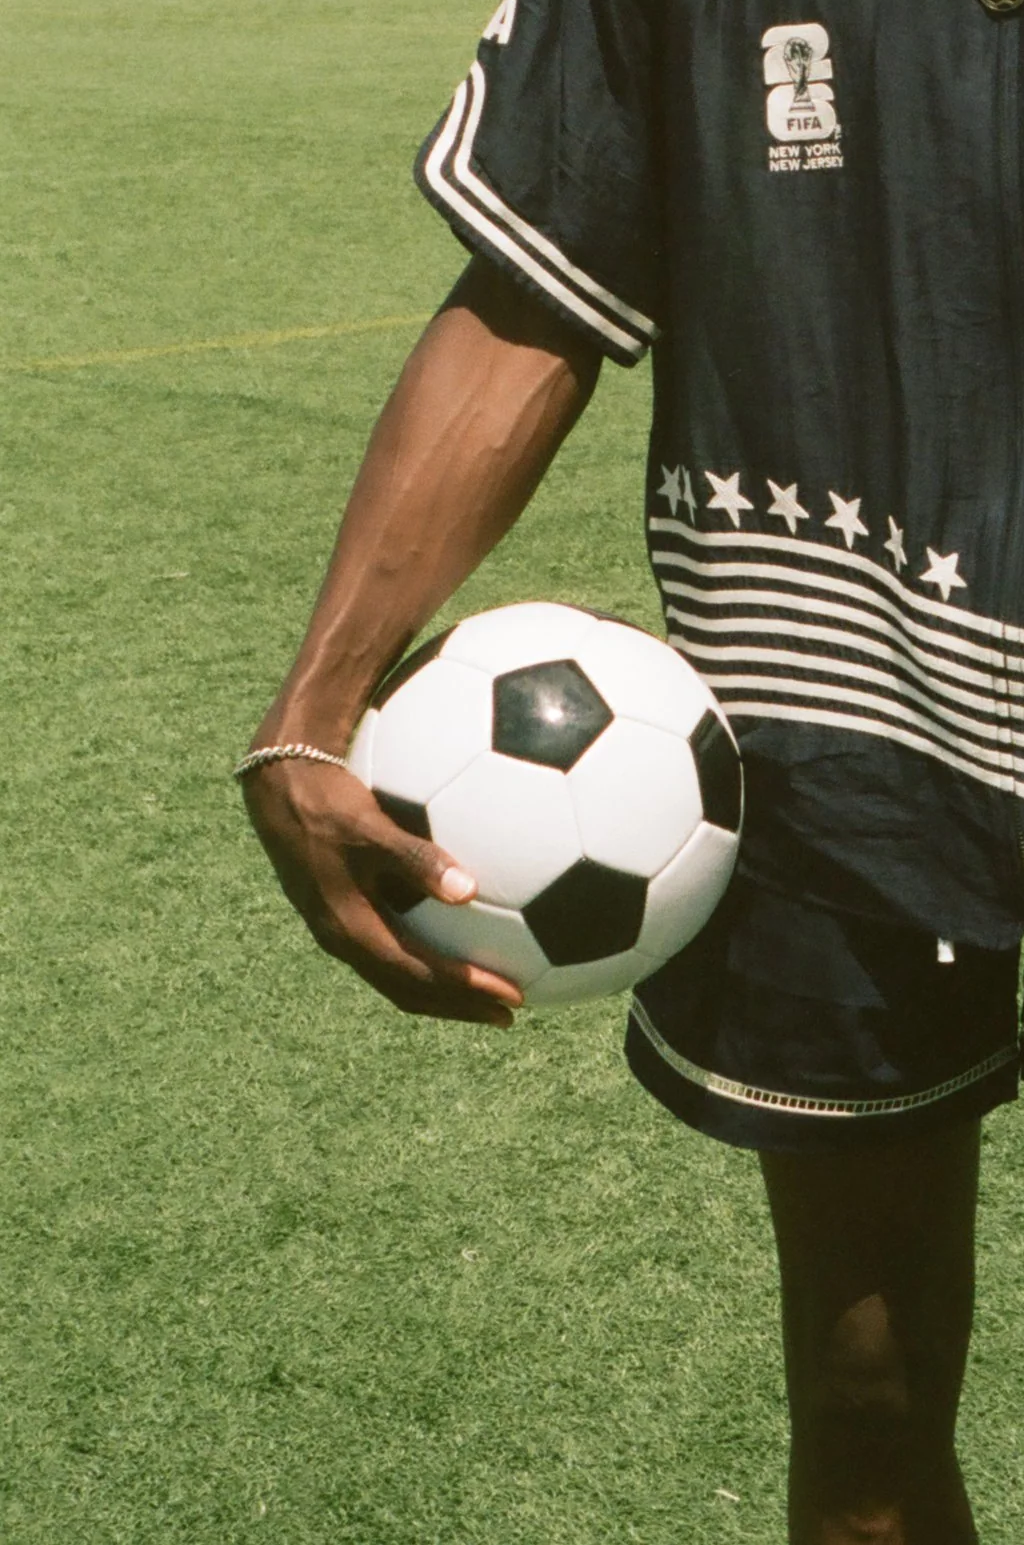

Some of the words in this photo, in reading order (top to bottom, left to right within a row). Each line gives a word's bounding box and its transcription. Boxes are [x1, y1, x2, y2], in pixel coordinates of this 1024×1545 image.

[787, 116, 822, 130] FIFA
[769, 145, 800, 158] NEW
[804, 142, 841, 157] YORK
[769, 159, 801, 171] NEW
[802, 156, 844, 170] JERSEY
